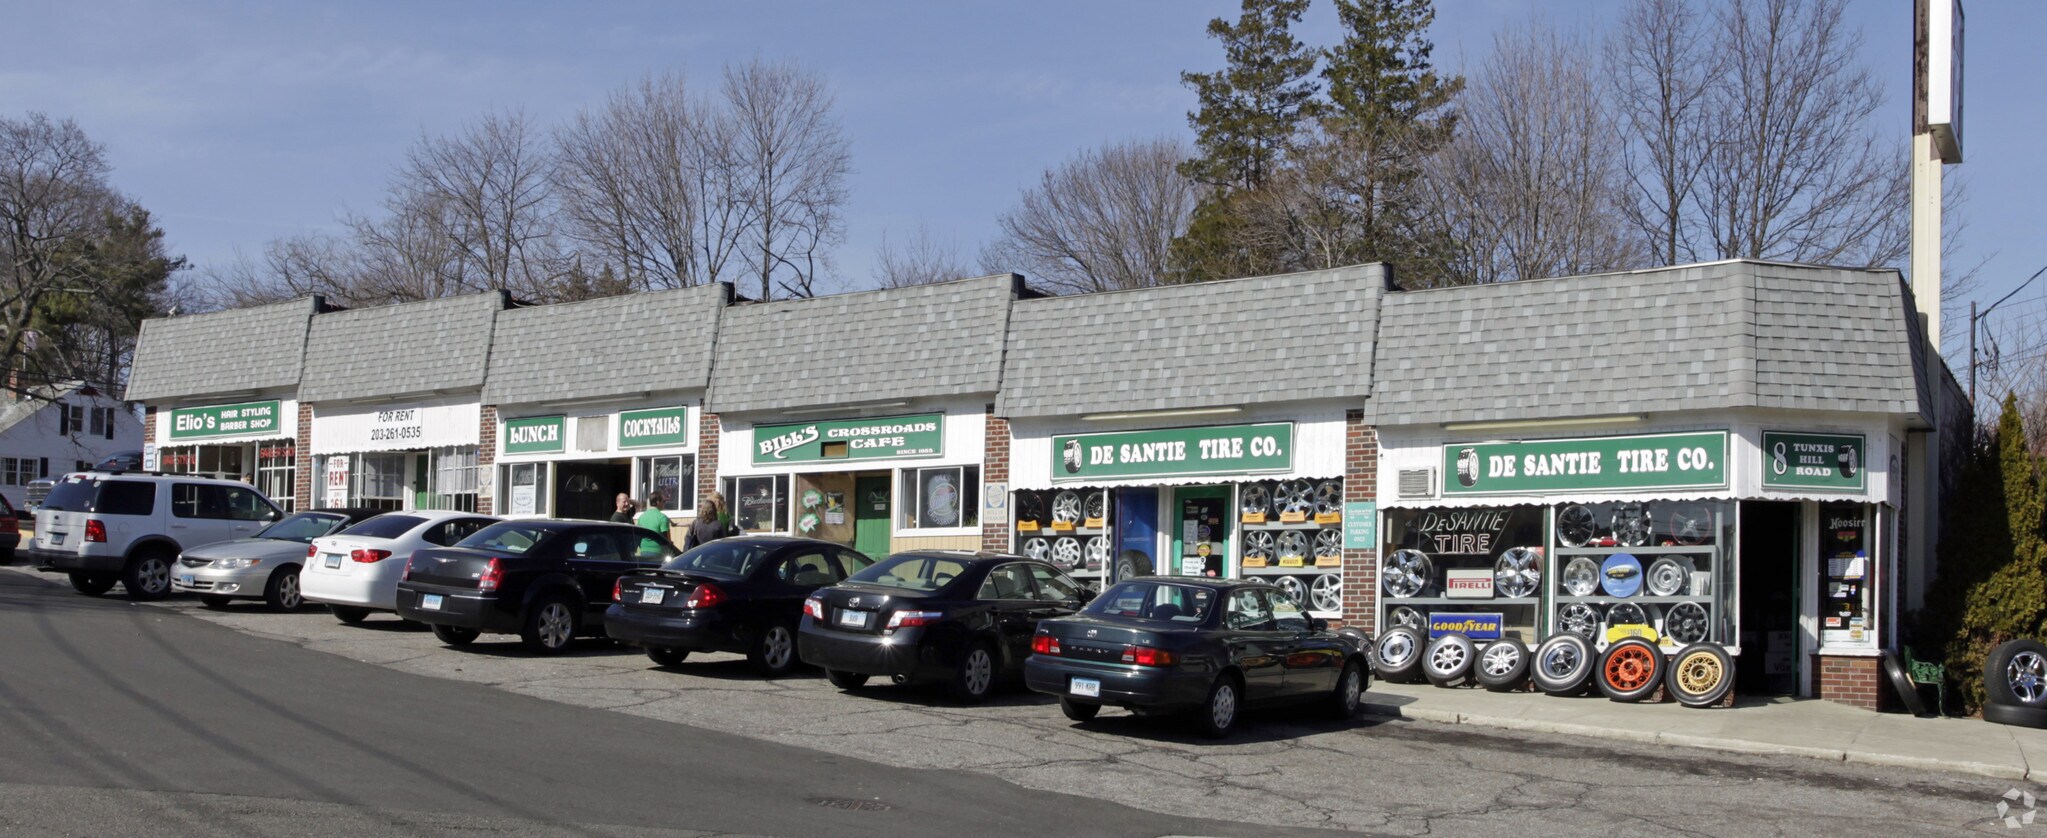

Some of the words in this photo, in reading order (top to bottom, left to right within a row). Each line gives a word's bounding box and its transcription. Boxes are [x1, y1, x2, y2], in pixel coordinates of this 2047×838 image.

[221, 410, 238, 419] HAIR
[242, 407, 271, 418] STYLING
[379, 411, 393, 422] FOR
[395, 410, 414, 422] RENT
[176, 413, 216, 431] Elio's
[220, 421, 247, 431] BARBER
[250, 419, 272, 428] SHOP
[624, 416, 680, 438] COCKTAILS
[371, 426, 420, 440] 203-261-0535
[510, 424, 558, 444] LUNCH
[758, 426, 818, 458] BILL'S
[828, 422, 936, 438] CROSSROADS
[850, 436, 904, 448] CAFE
[1090, 446, 1114, 464] DE
[1120, 442, 1186, 464] SANTIE
[1199, 438, 1244, 460] TIRE
[1250, 436, 1282, 457] CO.
[1488, 455, 1516, 478] DE
[1524, 452, 1601, 476] SANTIE
[1617, 449, 1669, 472] TIRE
[1677, 448, 1714, 470] CO.
[1773, 442, 1788, 474] 8
[1793, 444, 1834, 453] TUNXIS
[1800, 456, 1824, 464] HILL
[330, 470, 348, 486] RENT
[1796, 467, 1832, 476] ROAD
[1434, 534, 1490, 554] TIRE
[1448, 578, 1492, 588] PIRELLI
[1433, 620, 1496, 634] GOODYEAR
